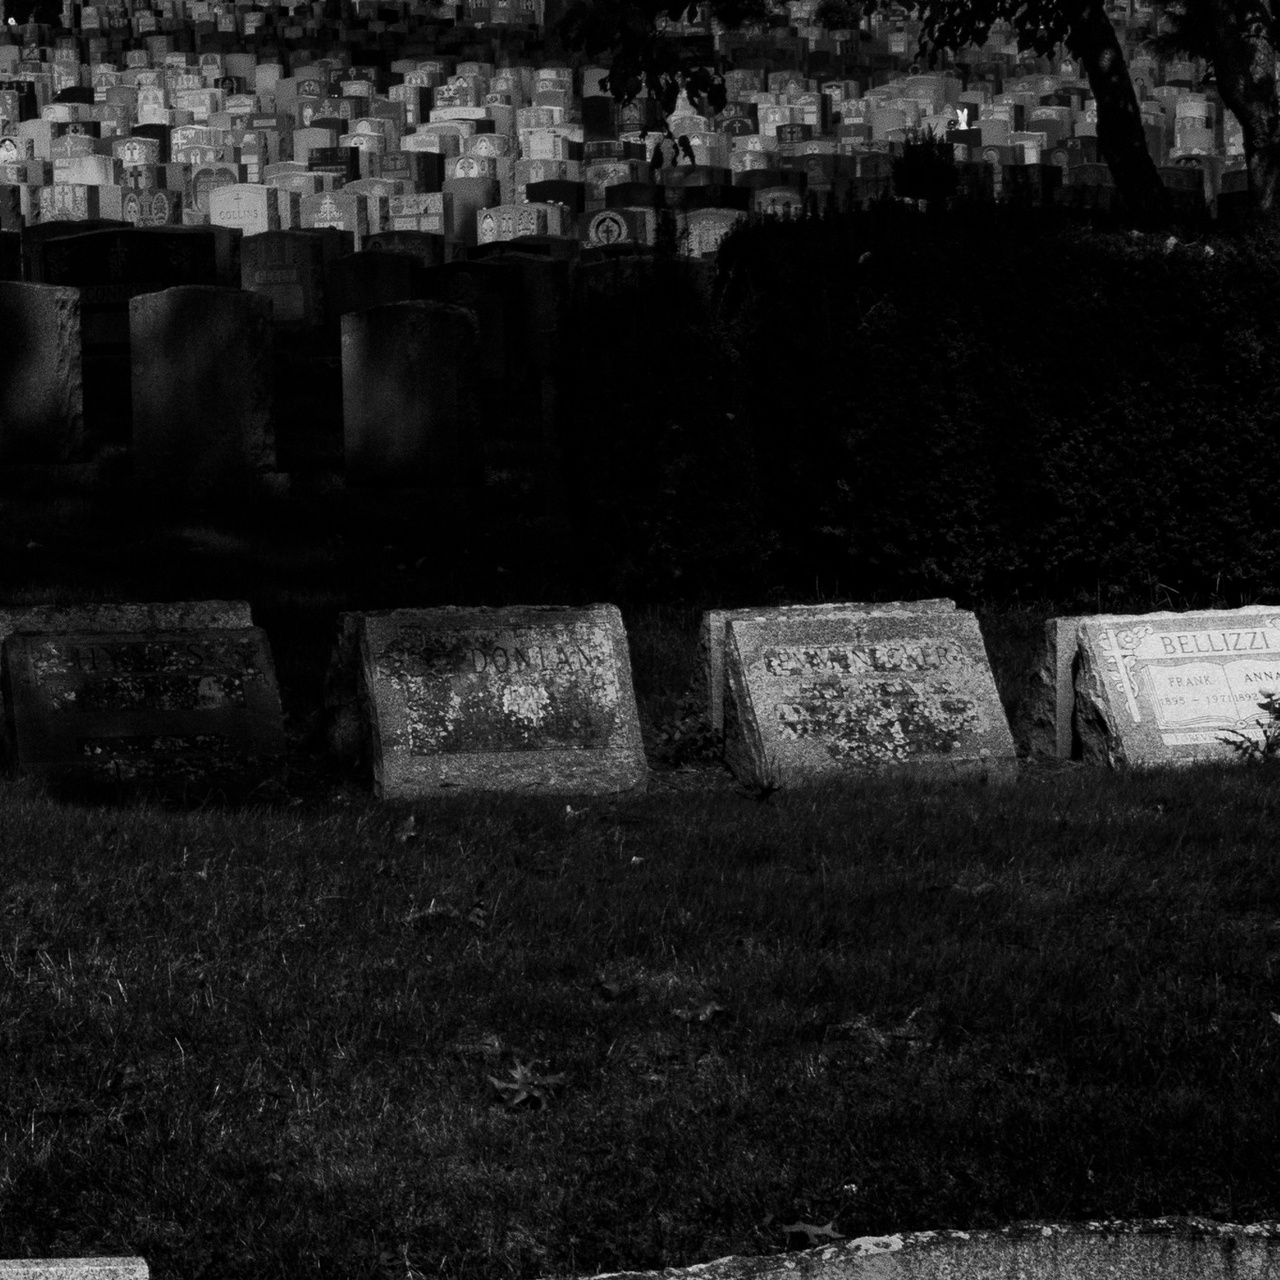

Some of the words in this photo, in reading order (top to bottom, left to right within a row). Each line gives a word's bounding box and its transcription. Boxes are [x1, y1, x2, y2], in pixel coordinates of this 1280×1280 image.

[219, 209, 259, 221] COLLINS
[1160, 631, 1270, 655] BELLIZZI
[1167, 675, 1213, 688] FRANK
